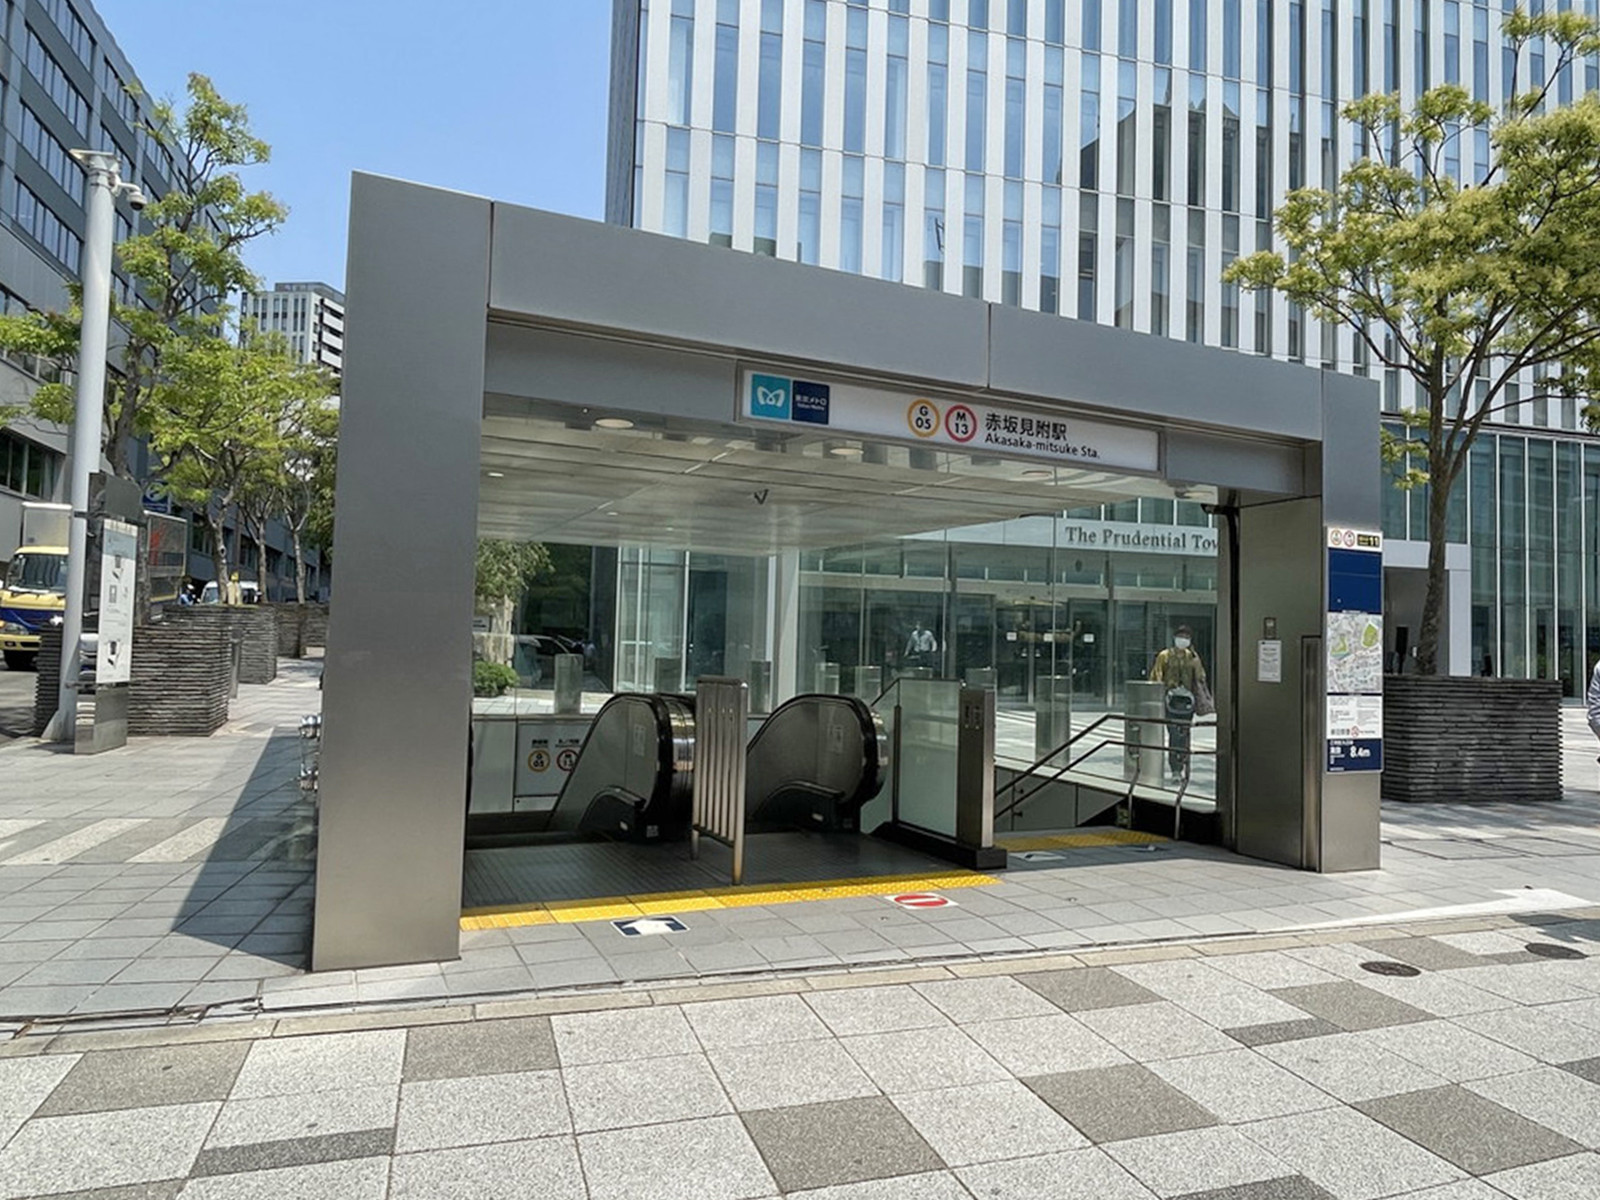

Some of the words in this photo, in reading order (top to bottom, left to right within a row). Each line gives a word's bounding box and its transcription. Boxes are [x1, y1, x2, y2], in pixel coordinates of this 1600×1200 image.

[919, 406, 928, 417] G
[956, 412, 967, 422] M
[915, 417, 931, 430] 05
[954, 423, 969, 435] 13
[985, 413, 1067, 441] 赤坂見附駅
[985, 433, 1078, 455] Akasaka-mitsuke
[1080, 446, 1100, 459] Sta.
[1065, 526, 1097, 543] The
[1103, 529, 1187, 549] Prudential
